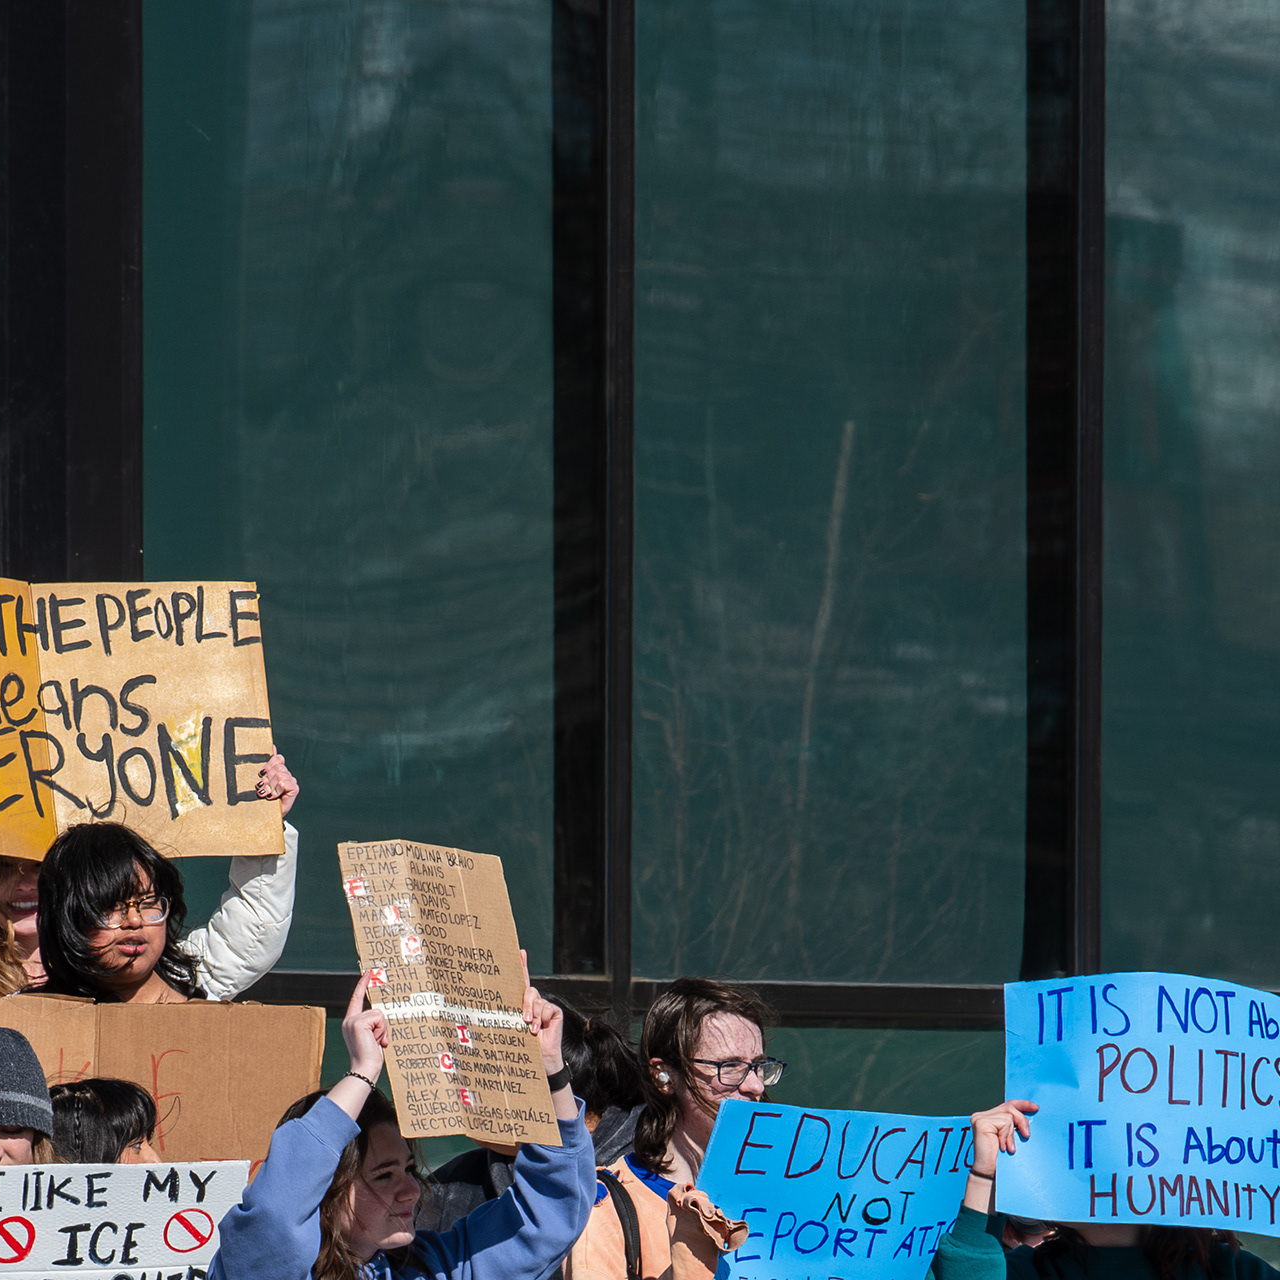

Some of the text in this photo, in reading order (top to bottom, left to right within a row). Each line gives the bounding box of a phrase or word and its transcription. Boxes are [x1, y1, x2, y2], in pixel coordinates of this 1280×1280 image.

[97, 586, 261, 656] PEOPLE
[410, 860, 444, 879] ALANIS
[421, 893, 450, 911] DAVIS
[419, 907, 448, 924] MATEO
[448, 912, 481, 930] LOPEZ
[414, 923, 447, 939] GOOD
[366, 939, 400, 956] JOSE
[369, 966, 466, 987] KEITH PORTER
[379, 981, 412, 996] RYAN
[418, 981, 450, 995] LOUIS
[381, 994, 440, 1010] ENRIQUE
[387, 1010, 429, 1026] ELENA
[1037, 986, 1074, 1045] IT
[1089, 983, 1131, 1036] IS
[1157, 985, 1236, 1035] NOT
[391, 1025, 416, 1042] AXEL
[393, 1042, 444, 1057] BARTOLO
[396, 1057, 440, 1070] ROBERTO
[504, 1065, 540, 1080] VALDEZ
[401, 1071, 440, 1089] YAHIR
[475, 1078, 526, 1094] MARTINEZ
[406, 1088, 440, 1103] ALEX
[410, 1115, 528, 1137] HECTOR LOPEZ LOPEZ
[1067, 1119, 1107, 1170] IT
[1126, 1122, 1160, 1168] IS
[143, 1169, 217, 1204] MY
[822, 1191, 915, 1225] NOT
[52, 1221, 144, 1267] ICE
